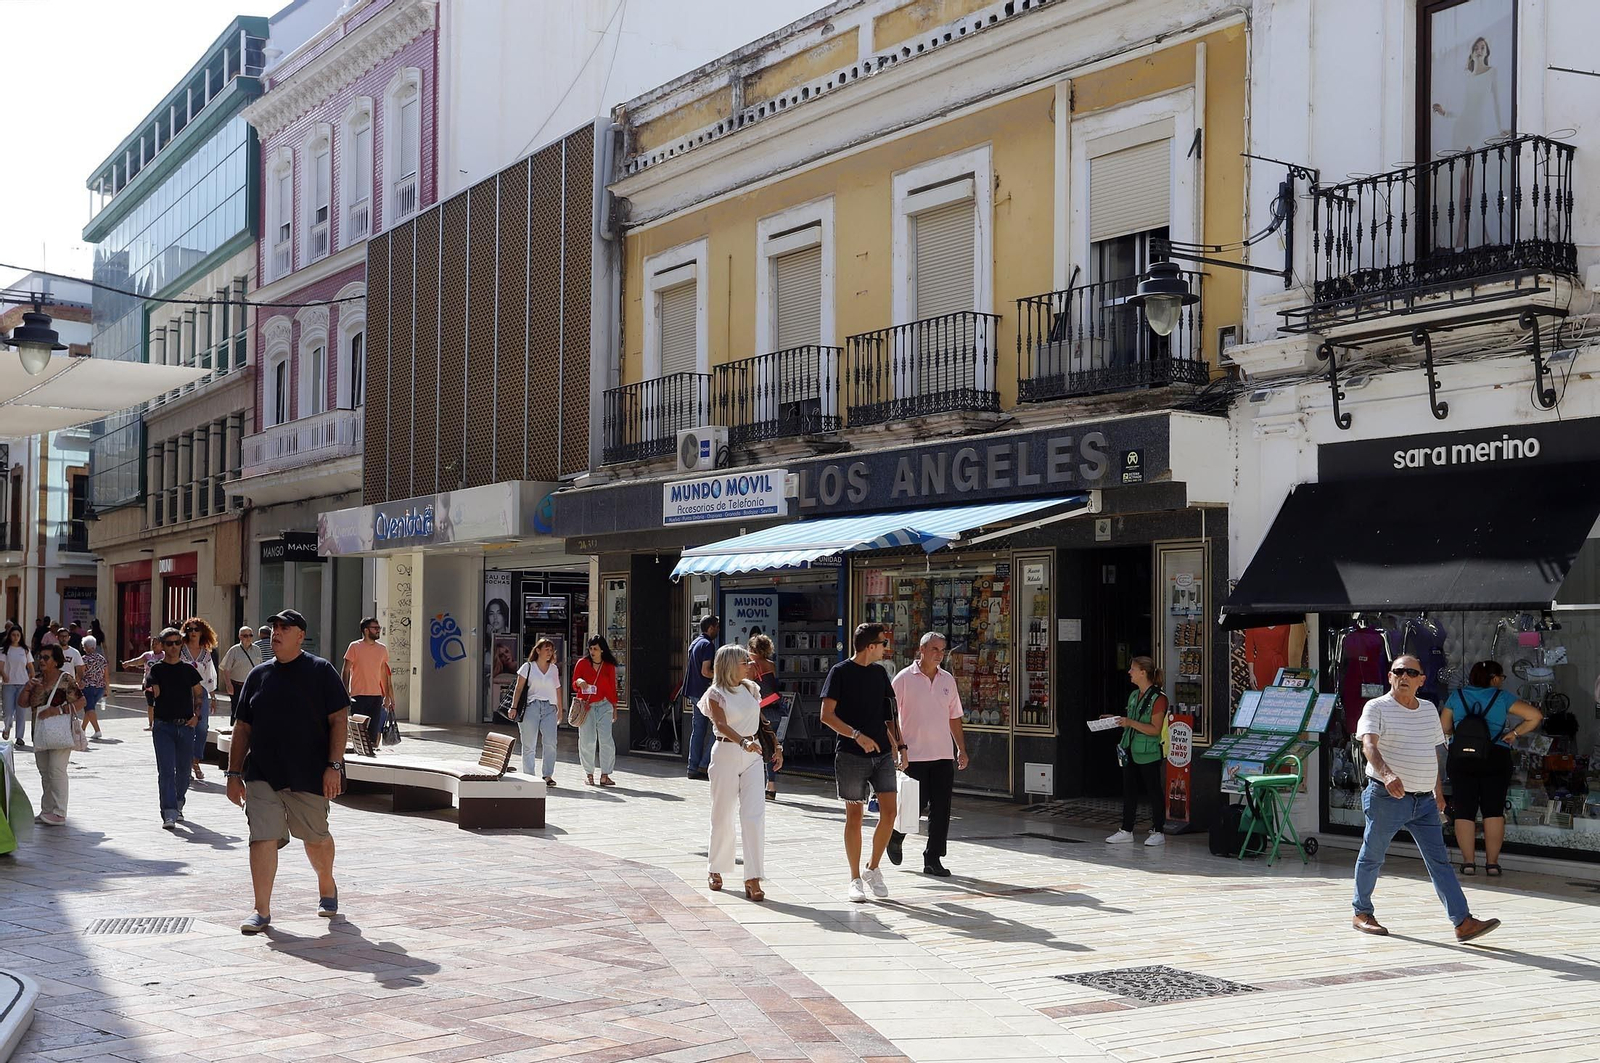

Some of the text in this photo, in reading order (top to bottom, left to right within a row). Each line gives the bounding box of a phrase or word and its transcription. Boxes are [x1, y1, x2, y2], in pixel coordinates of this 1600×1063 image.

[1393, 434, 1540, 469] sara merino
[800, 431, 1108, 507] LOS ANGELES
[671, 474, 773, 502] MUNDO MOVIL
[677, 497, 764, 514] Accesorios de Telefonía
[263, 545, 285, 558] MANGO
[287, 543, 318, 551] MANG
[734, 597, 773, 607] MUNDO
[737, 608, 770, 618] MOVIL
[1173, 729, 1187, 737] Para
[1171, 735, 1188, 743] llevar
[1171, 743, 1188, 751] Take
[1170, 750, 1188, 759] away
